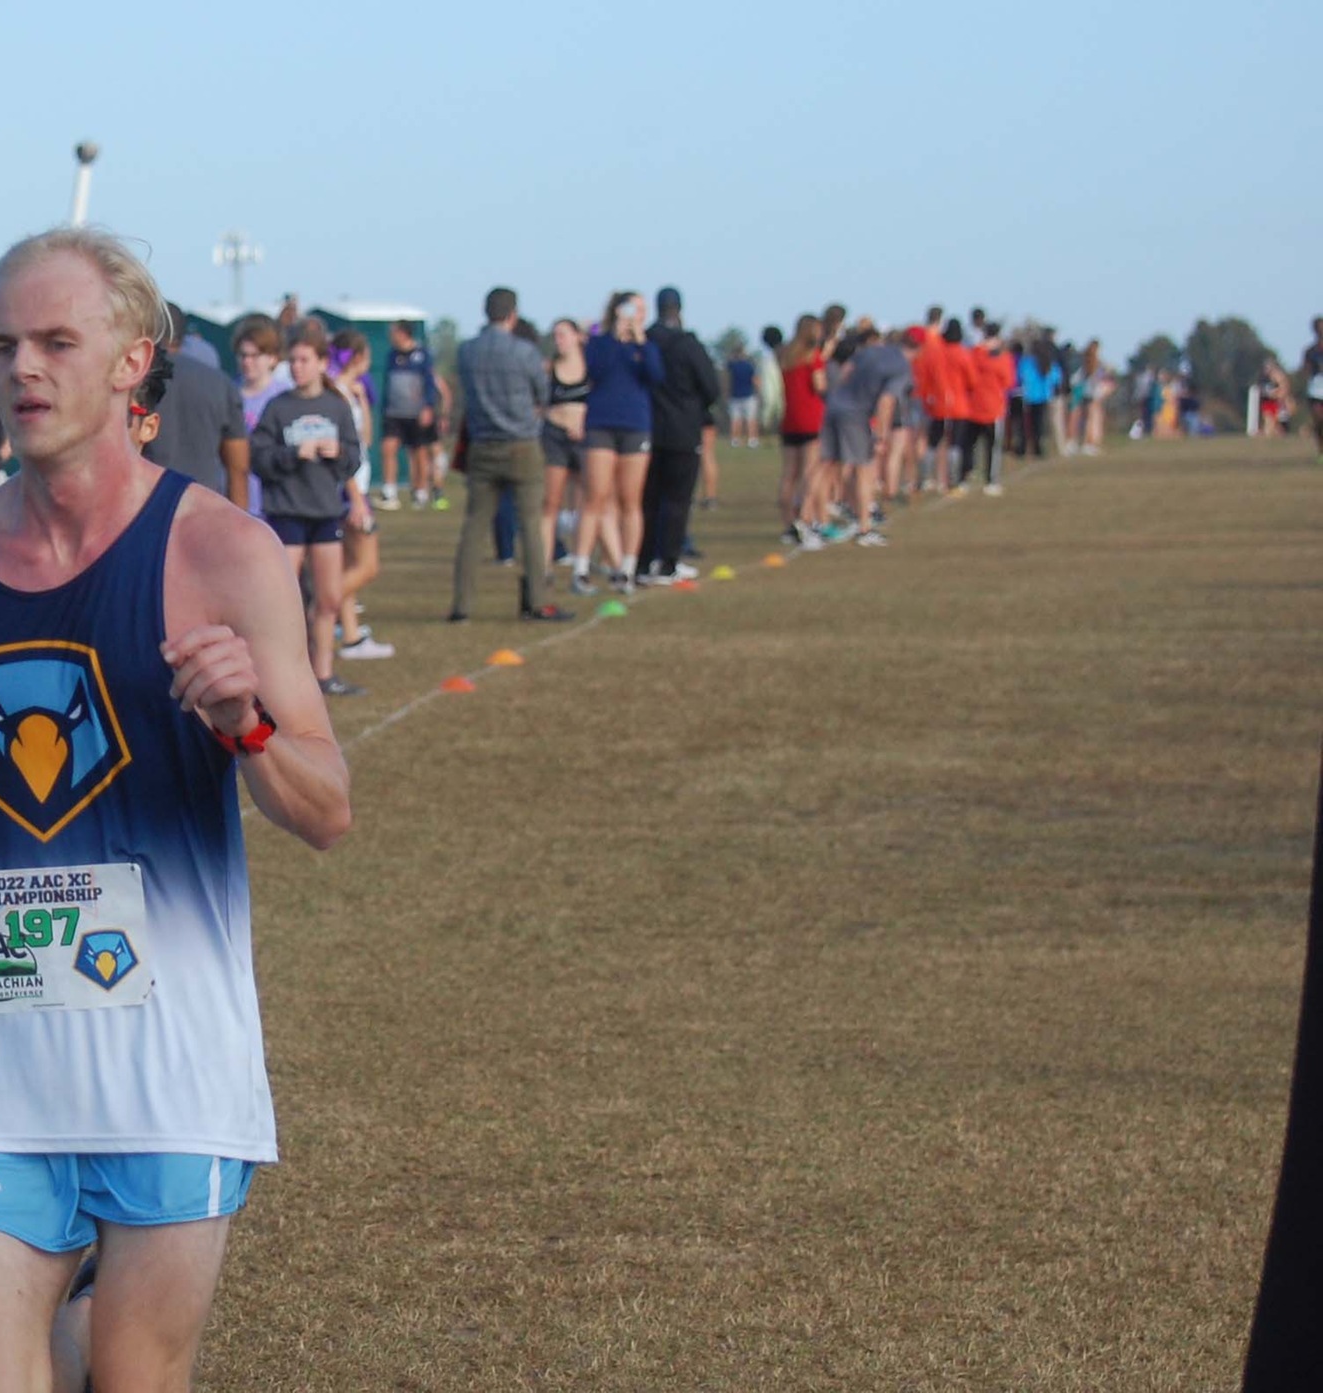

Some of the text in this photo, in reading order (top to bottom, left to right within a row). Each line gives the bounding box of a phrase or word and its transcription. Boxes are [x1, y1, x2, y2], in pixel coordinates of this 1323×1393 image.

[29, 874, 63, 889] AAC
[67, 872, 92, 887] XC
[5, 907, 80, 948] 197
